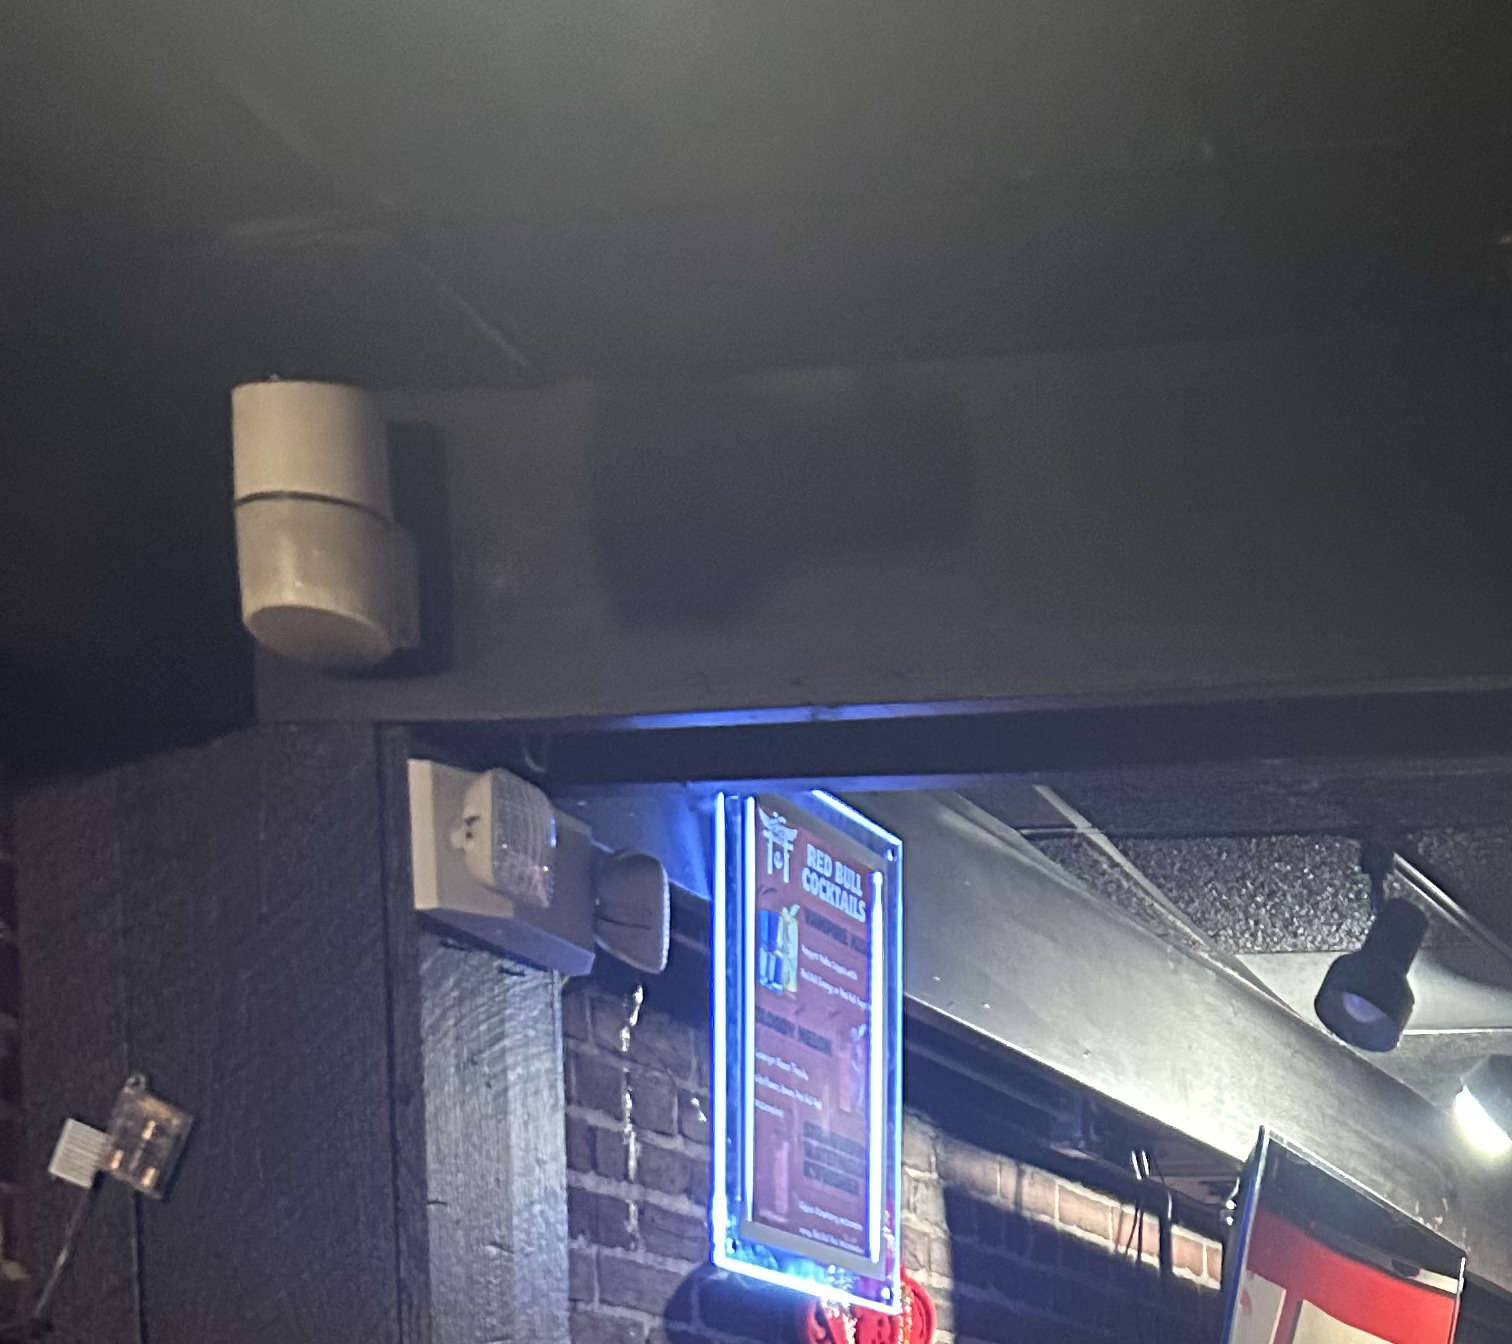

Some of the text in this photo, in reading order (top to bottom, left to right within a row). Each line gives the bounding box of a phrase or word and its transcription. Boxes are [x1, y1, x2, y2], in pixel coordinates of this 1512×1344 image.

[801, 866, 867, 922] COCKTAILS
[806, 843, 863, 897] RED BULL
